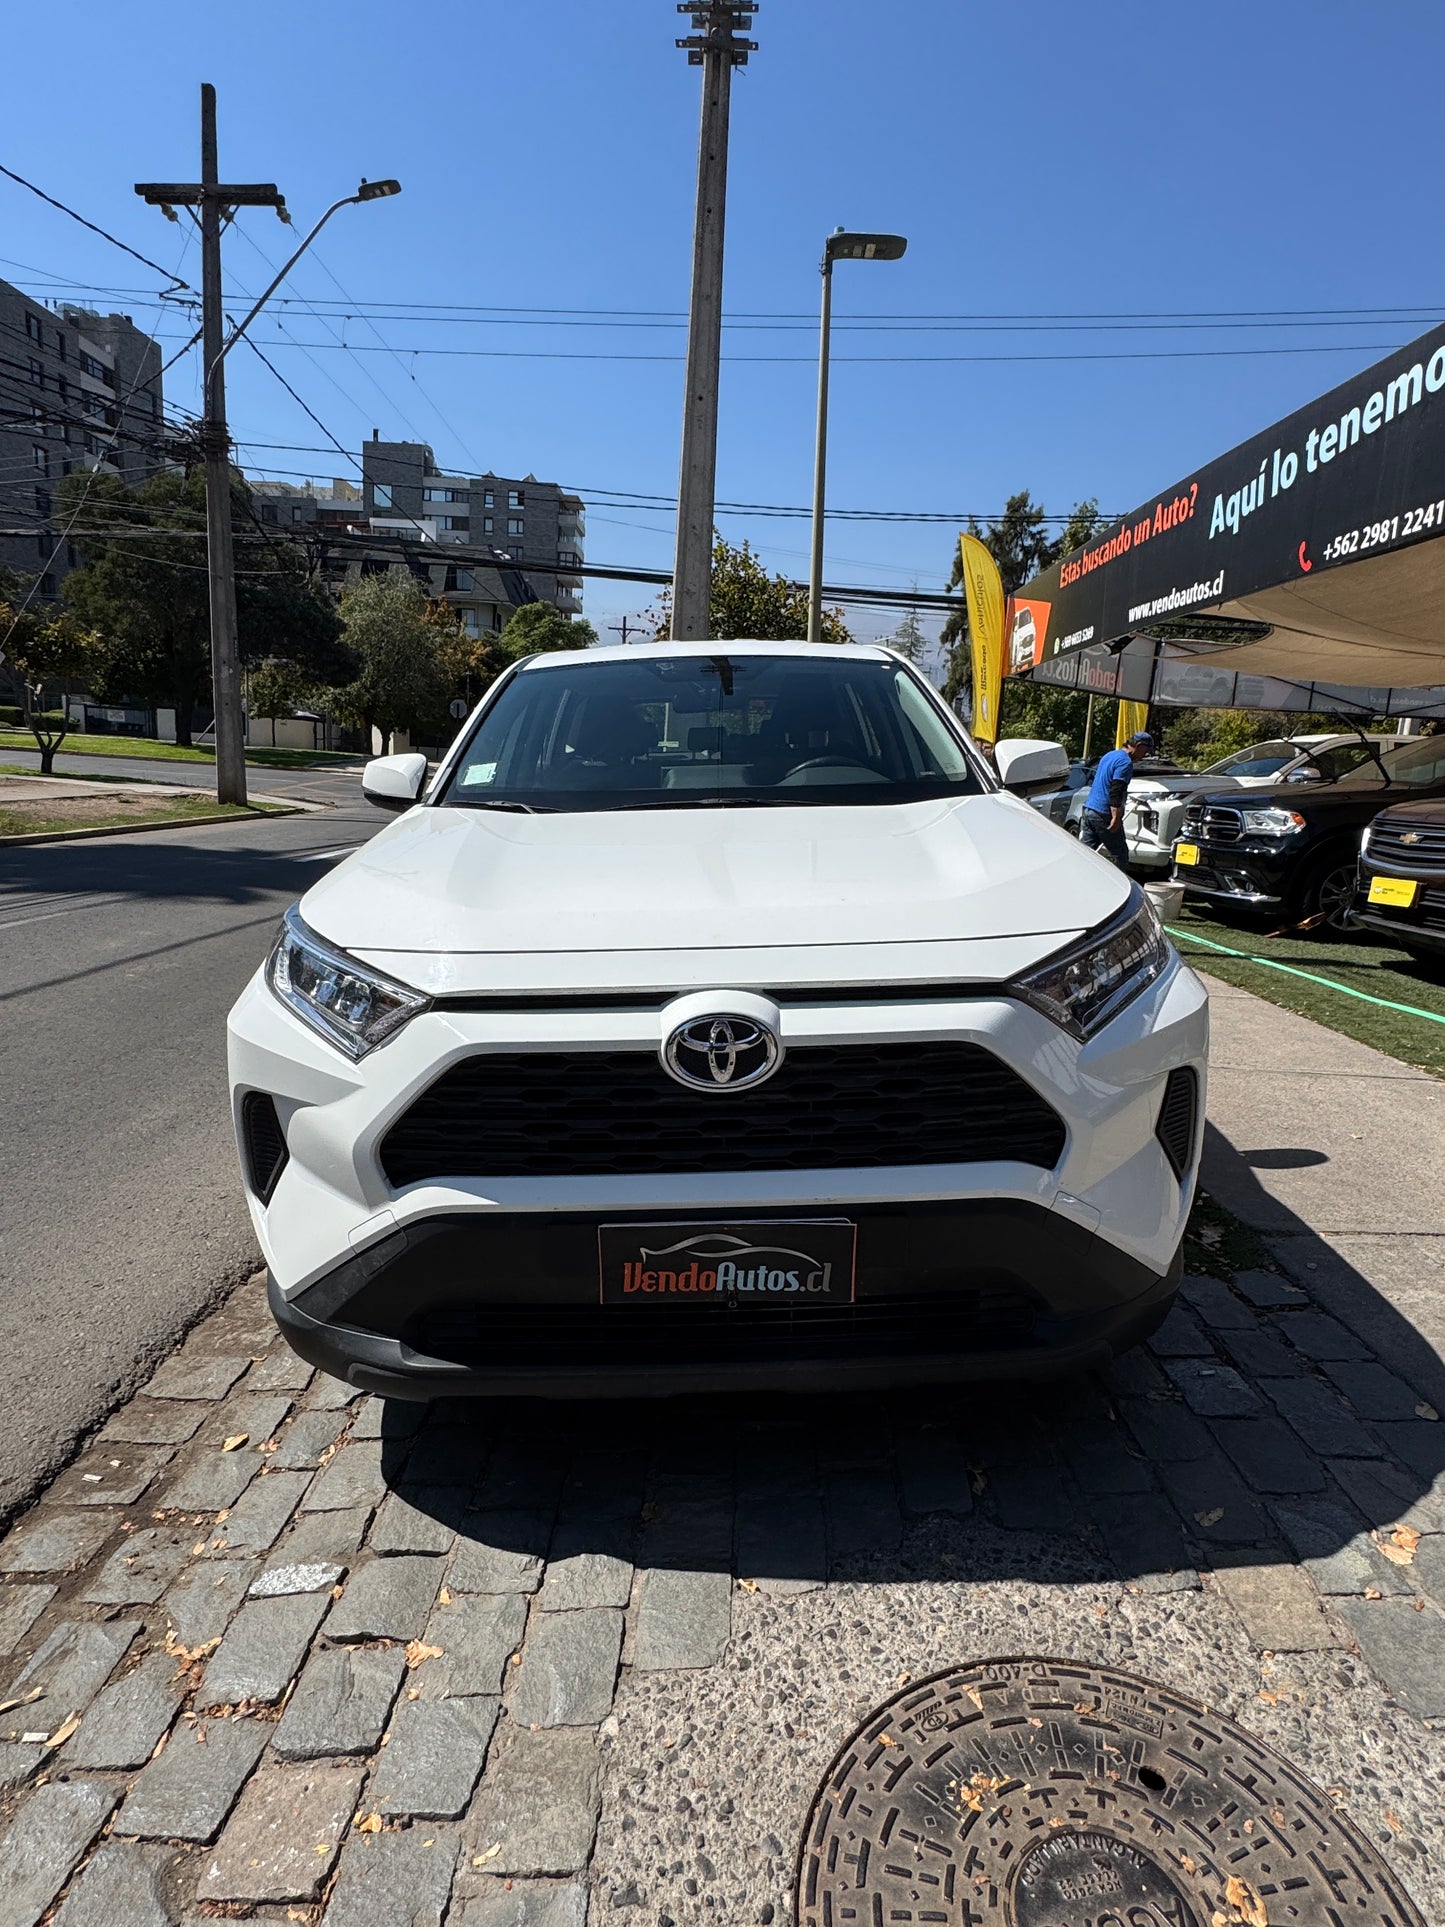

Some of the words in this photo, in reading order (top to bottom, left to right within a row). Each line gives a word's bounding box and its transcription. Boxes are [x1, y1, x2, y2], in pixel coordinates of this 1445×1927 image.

[1209, 458, 1268, 539] Aquí
[1271, 448, 1298, 498] lo
[1306, 345, 1445, 473] tenemo
[1059, 560, 1081, 589] Estas
[1082, 525, 1132, 577] buscando
[1133, 518, 1151, 547] un
[1152, 482, 1199, 536] Auto?
[1322, 530, 1358, 561] +562
[1360, 516, 1398, 550] 2981
[1401, 499, 1445, 537] 2241
[1128, 569, 1225, 623] www.vendoautos.cl
[623, 1261, 832, 1293] VendoAutos.cl
[984, 1663, 1047, 1681] D-400
[1104, 1686, 1126, 1702] 124
[1021, 1832, 1150, 1886] ALCANTARILLADO
